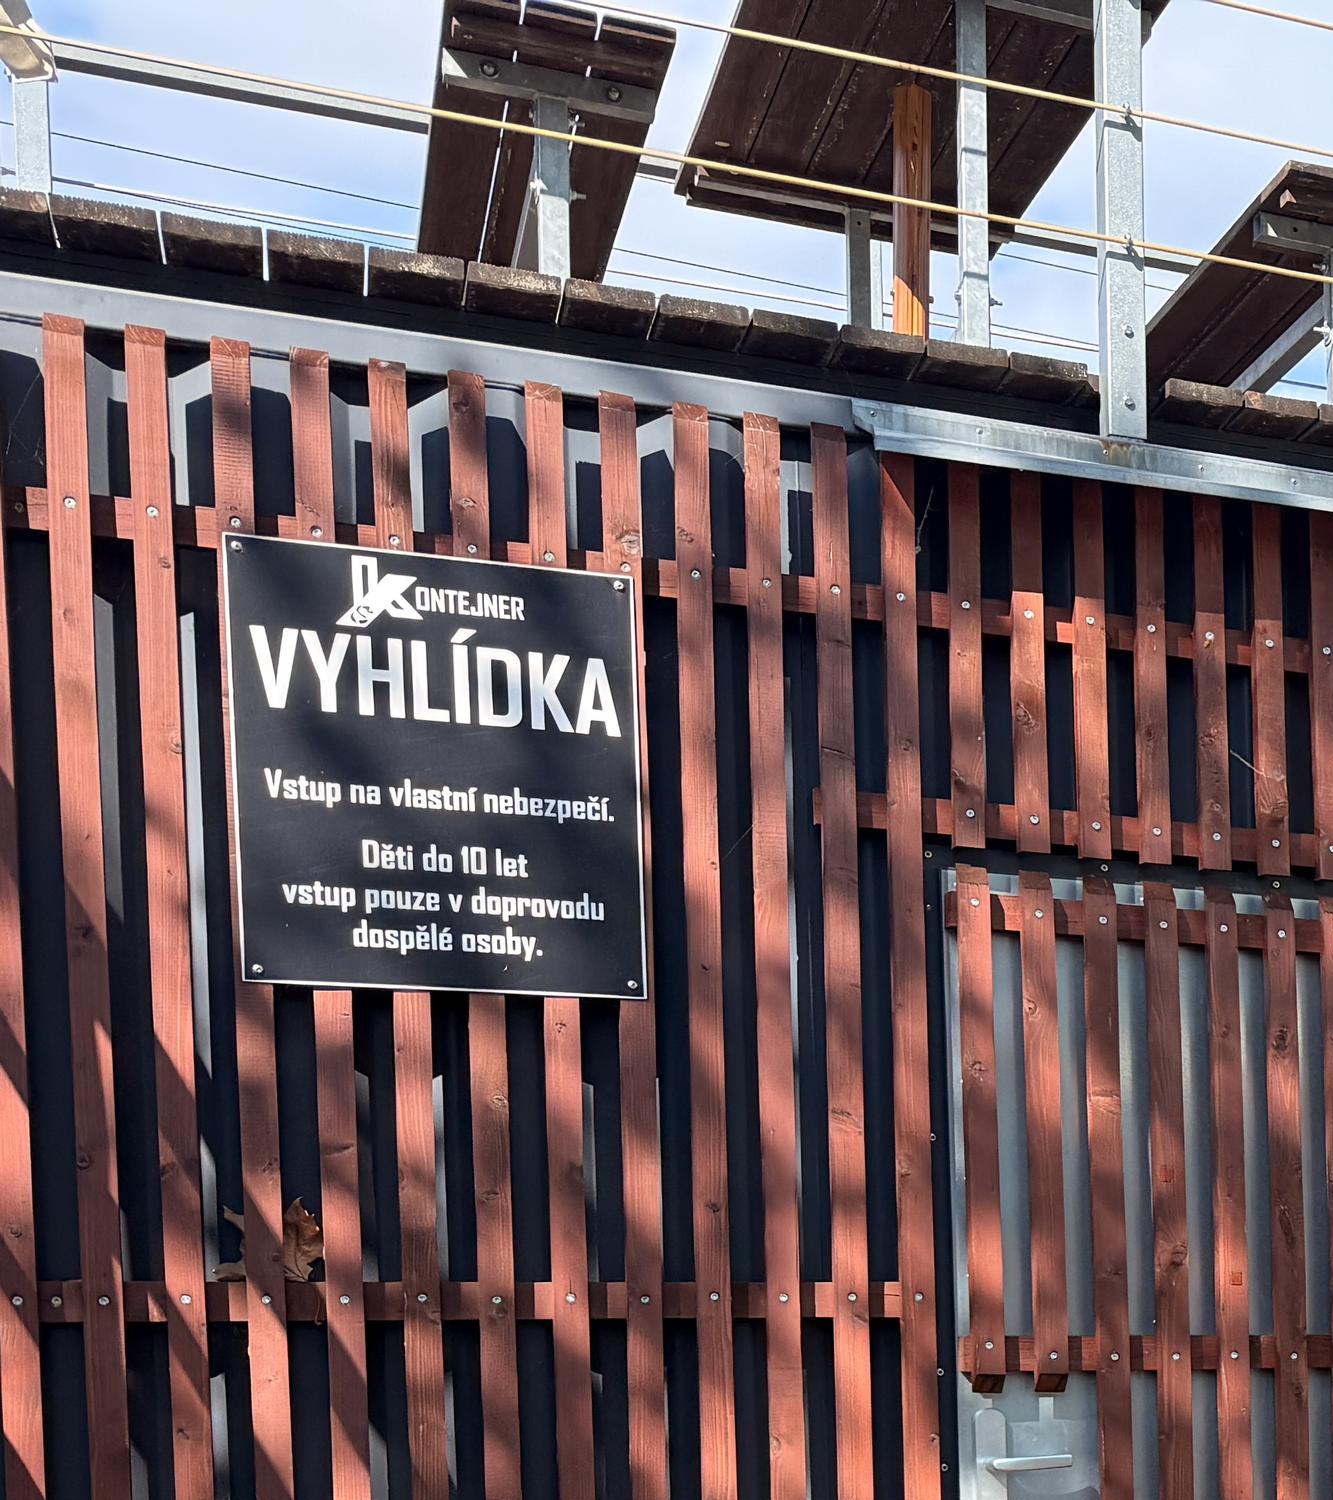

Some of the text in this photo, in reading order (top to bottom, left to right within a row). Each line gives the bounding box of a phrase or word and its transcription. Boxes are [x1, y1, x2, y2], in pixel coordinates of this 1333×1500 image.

[249, 624, 622, 738] VYHLÍDKA
[264, 768, 615, 824] Vstup na vlastní nebezpečí.
[362, 839, 529, 878] Děti do 10 let
[282, 881, 605, 922] vstup pouze v doprovodu
[353, 919, 544, 962] dospělé osoby.
